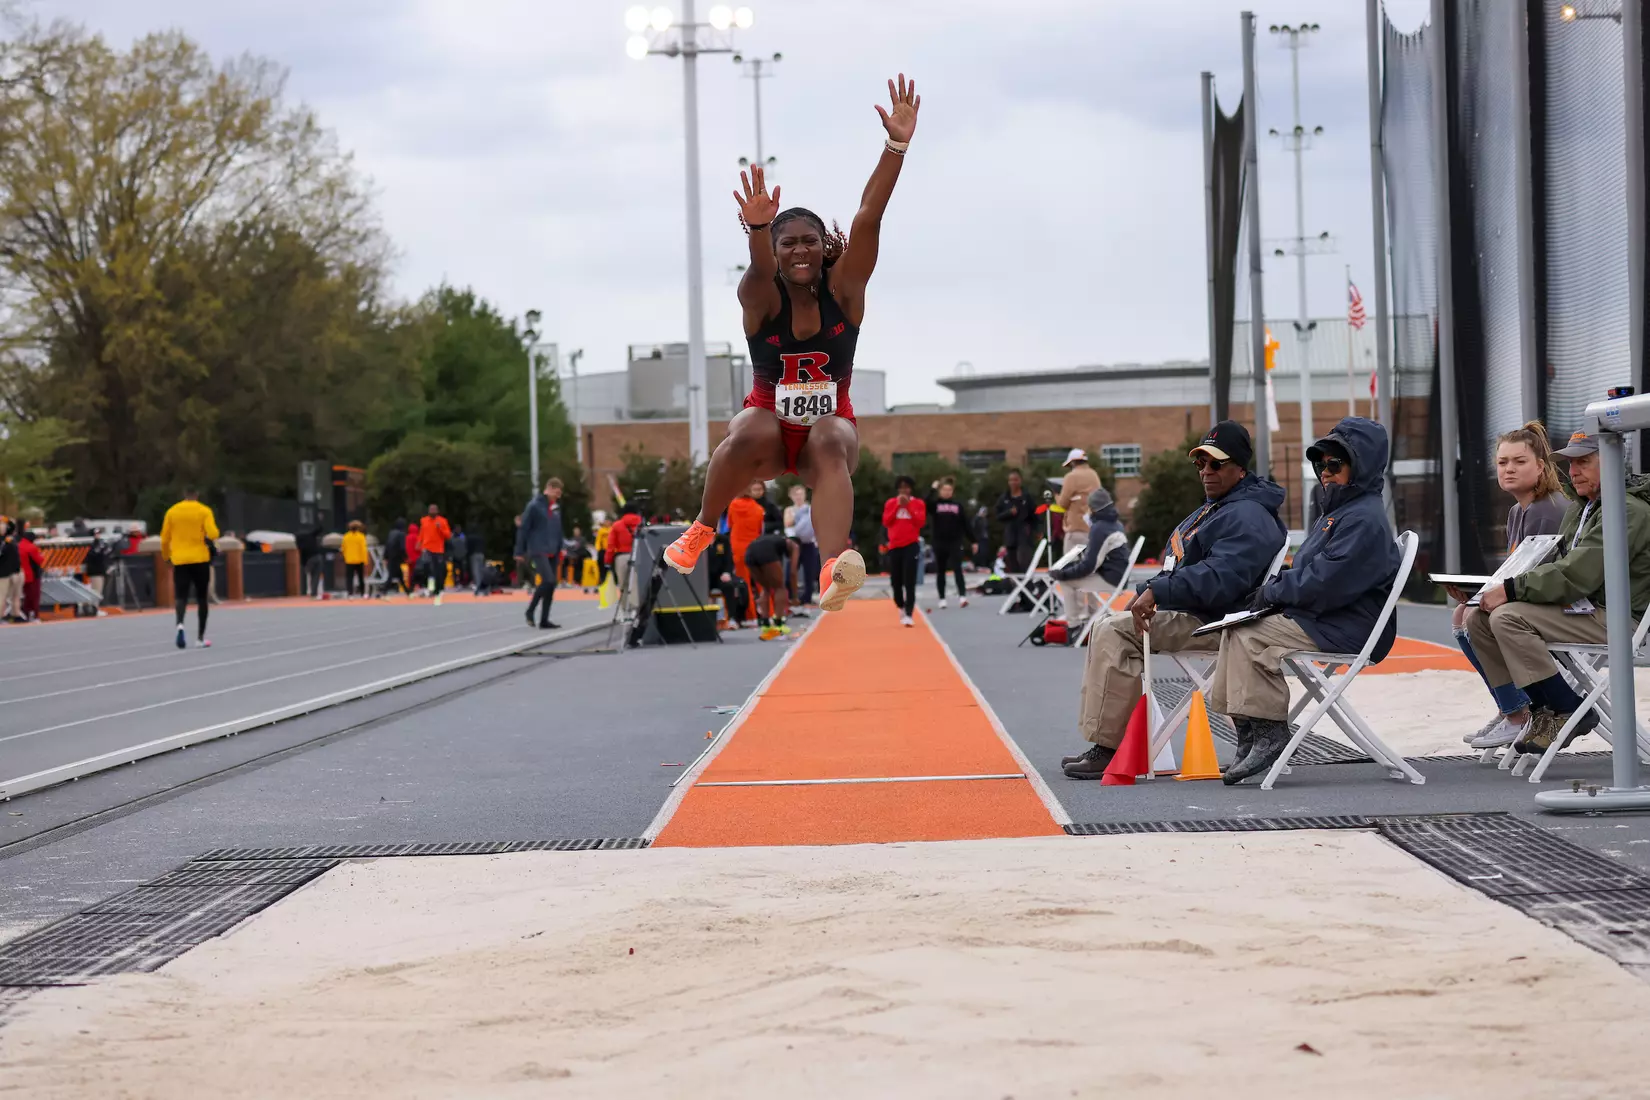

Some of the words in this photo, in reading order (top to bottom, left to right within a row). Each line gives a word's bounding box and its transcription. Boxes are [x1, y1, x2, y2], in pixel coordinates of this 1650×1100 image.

[779, 351, 832, 384] R
[784, 382, 828, 391] TENNESSEE
[781, 395, 832, 417] 1849
